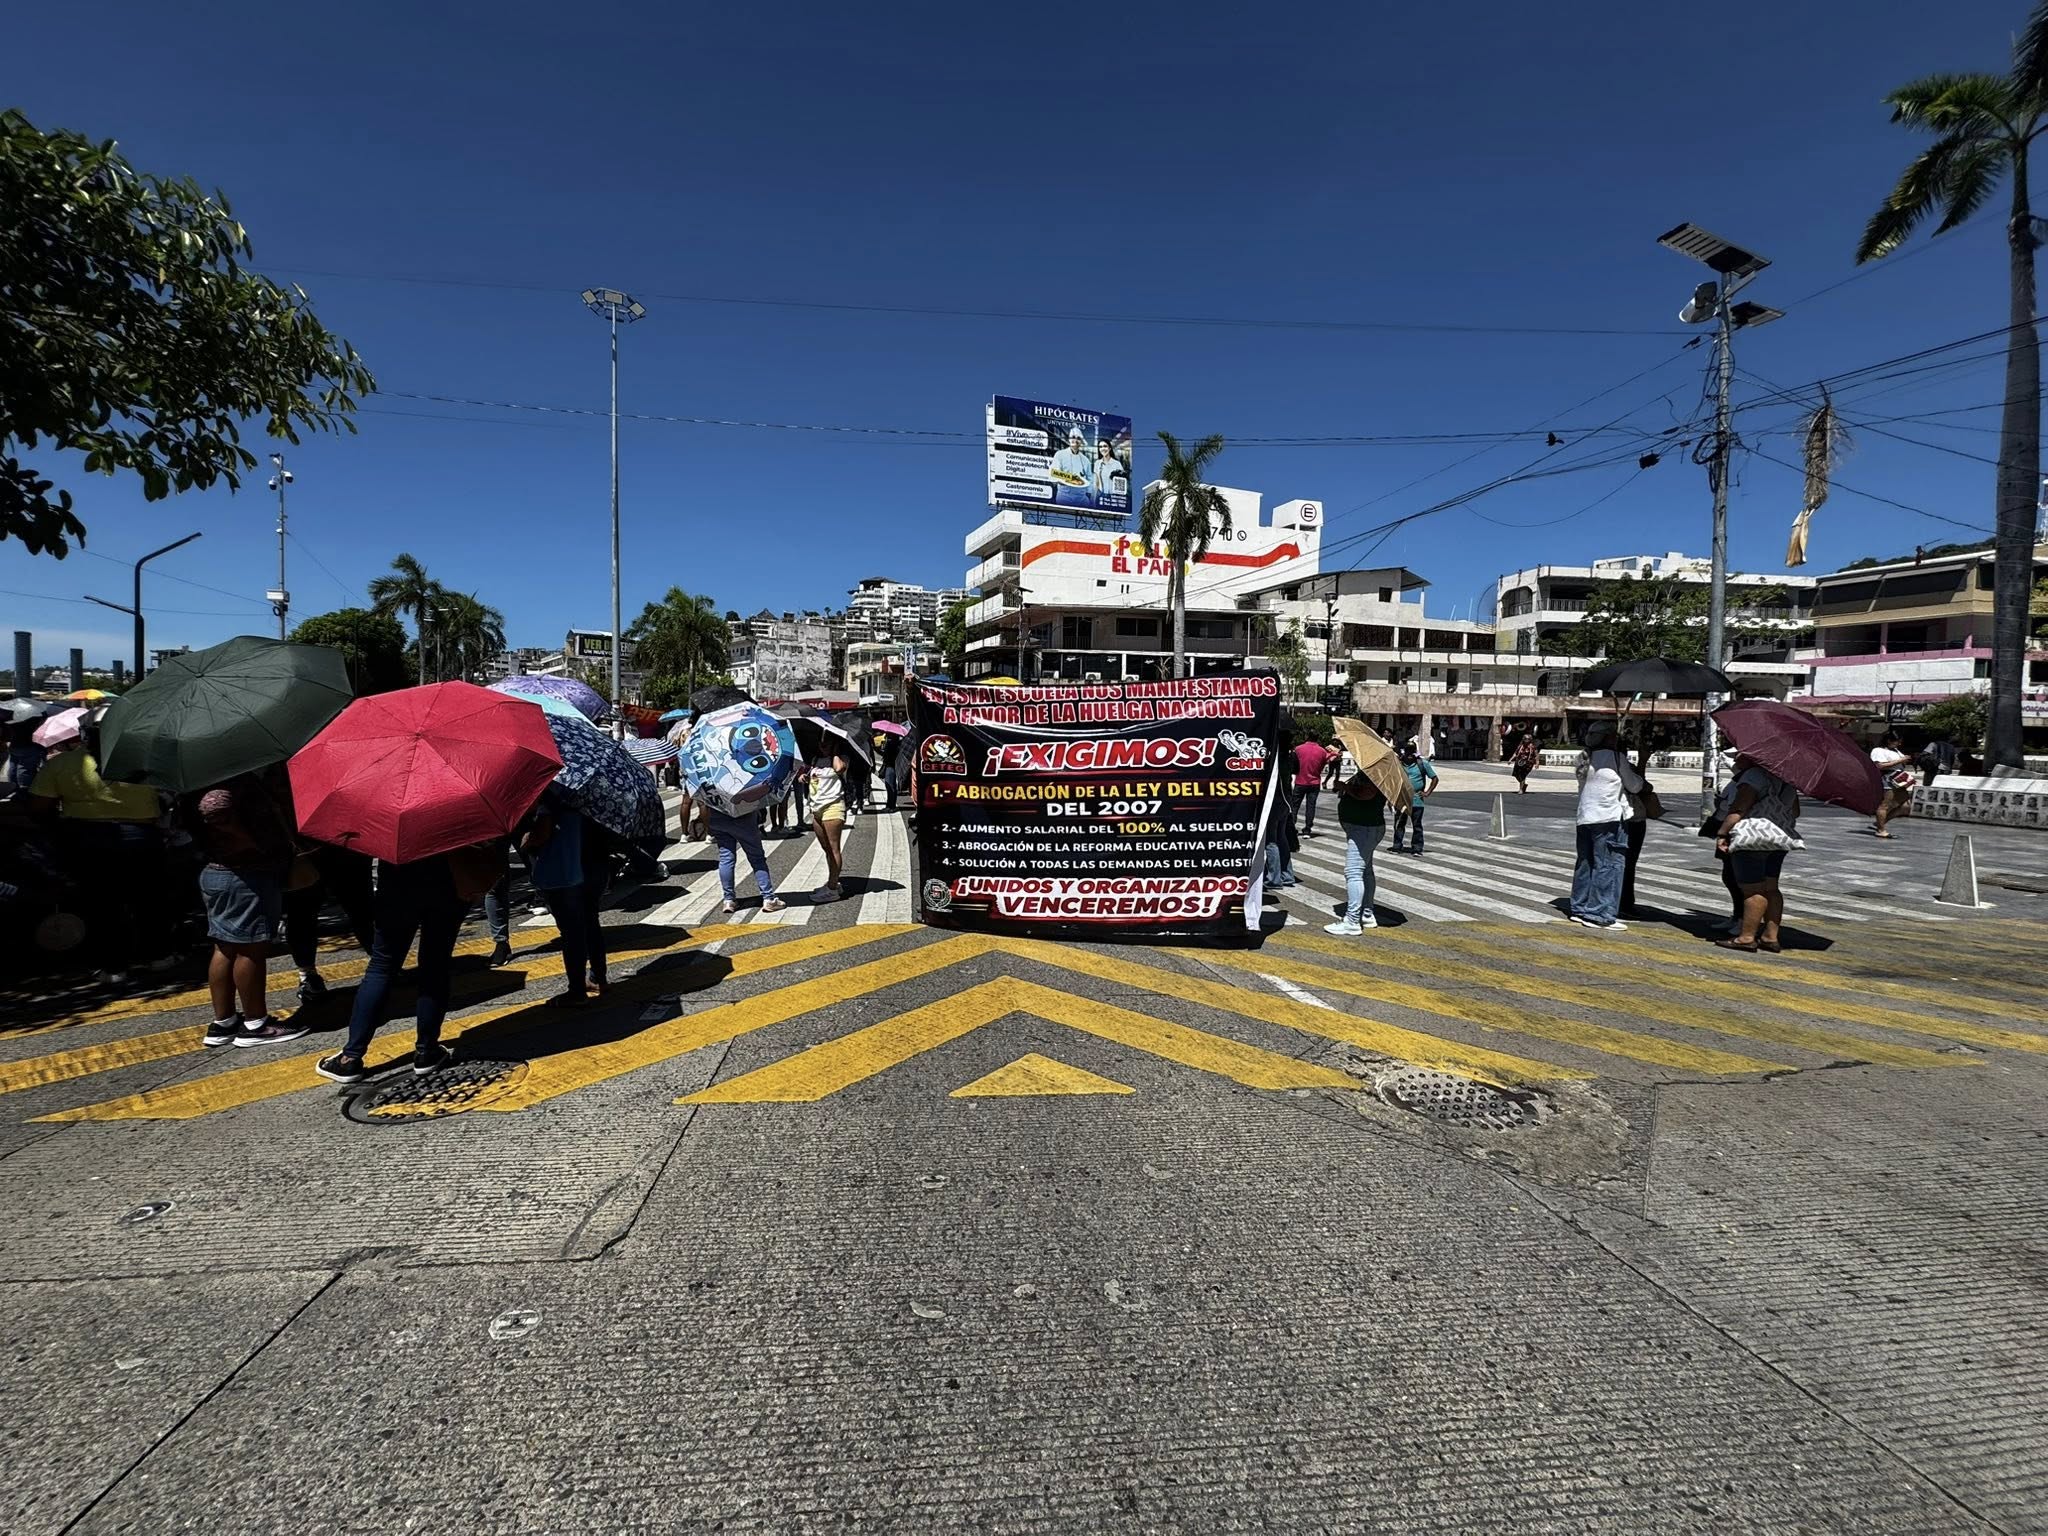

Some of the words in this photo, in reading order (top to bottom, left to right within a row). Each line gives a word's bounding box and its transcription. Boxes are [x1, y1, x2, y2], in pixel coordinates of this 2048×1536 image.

[1034, 405, 1099, 424] HIPÓCRATES
[1006, 438, 1044, 448] estudiando
[1005, 465, 1026, 474] Digital
[1112, 556, 1131, 573] EL
[946, 687, 992, 705] ESTA
[995, 686, 1079, 704] ESCUELA
[1082, 684, 1122, 700] NOS
[1125, 677, 1277, 699] MANIFESTAMOS
[944, 707, 957, 724] A
[960, 705, 1020, 725] FAVOR
[1023, 704, 1050, 725] DE
[1052, 703, 1077, 723] LA
[1079, 701, 1154, 721] HUELGA
[1156, 699, 1255, 719] NACIONAL
[982, 738, 1219, 777] ¡EXIGIMOS!
[932, 783, 950, 798] 1.-
[956, 782, 1070, 800] ABROGACIÓN
[1076, 786, 1095, 798] DE
[1100, 786, 1120, 798] LA
[1125, 782, 1162, 798] LEY
[1168, 782, 1204, 797] DEL
[1047, 803, 1091, 817] DEL
[1098, 801, 1162, 815] 2007
[942, 823, 957, 833] 2.-
[959, 824, 1022, 834] AUMENTO
[1024, 825, 1086, 834] SALARIAL
[1089, 824, 1114, 834] DEL
[1117, 822, 1166, 834] 100%
[1169, 823, 1186, 832] AL
[1189, 822, 1244, 832] SUELDO
[942, 841, 956, 850] 3.-
[958, 841, 1035, 852] ABROGACIÓN
[1036, 843, 1052, 852] DE
[1054, 843, 1070, 852] LA
[1073, 842, 1133, 852] REFORMA
[1135, 841, 1205, 851] EDUCATIVA
[1208, 839, 1255, 850] PEÑA-A
[942, 858, 956, 866] 4.-
[959, 858, 1016, 868] SOLUCIÓN
[1018, 860, 1028, 868] A
[1030, 860, 1070, 869] TODAS
[1073, 860, 1096, 869] LAS
[1099, 859, 1171, 869] DEMANDAS
[1174, 859, 1198, 868] DEL
[956, 877, 1053, 897] ¡UNIDOS
[1058, 879, 1076, 894] Y
[1077, 878, 1249, 895] ORGANIZADOS
[1003, 896, 1214, 914] VENCEREMOS!
